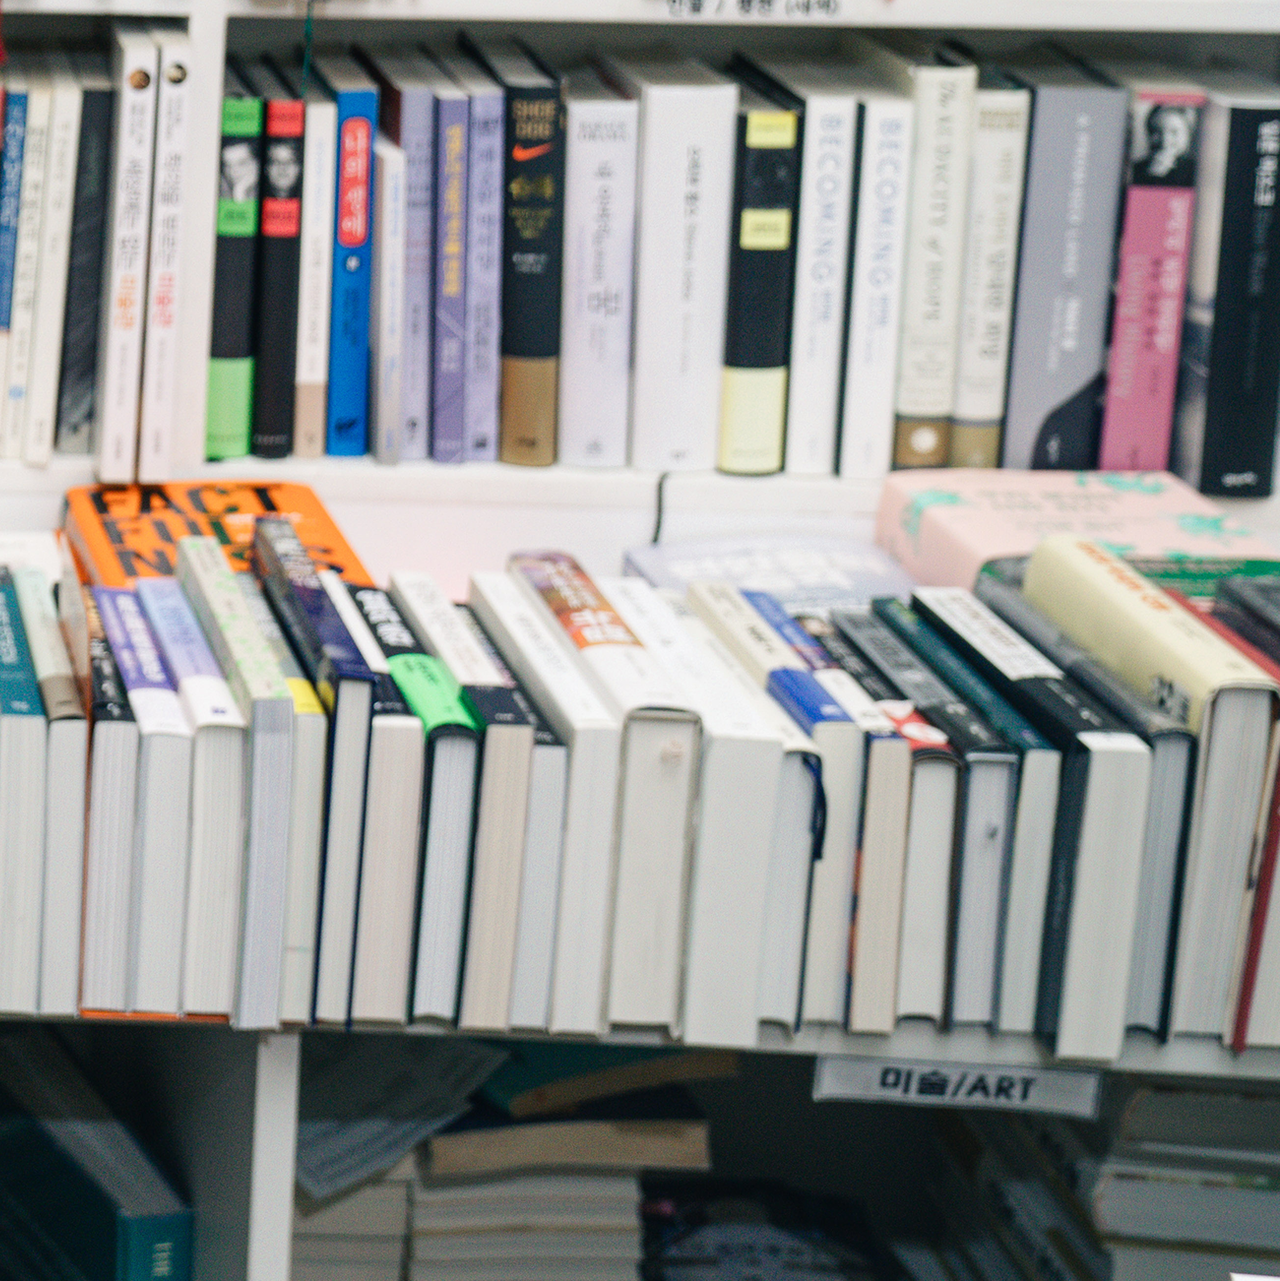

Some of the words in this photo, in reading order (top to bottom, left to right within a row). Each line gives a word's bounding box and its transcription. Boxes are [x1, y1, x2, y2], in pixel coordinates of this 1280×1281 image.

[809, 114, 844, 282] BECOMING
[867, 118, 903, 289] BECOMING
[878, 1065, 1039, 1103] 미술/ART
